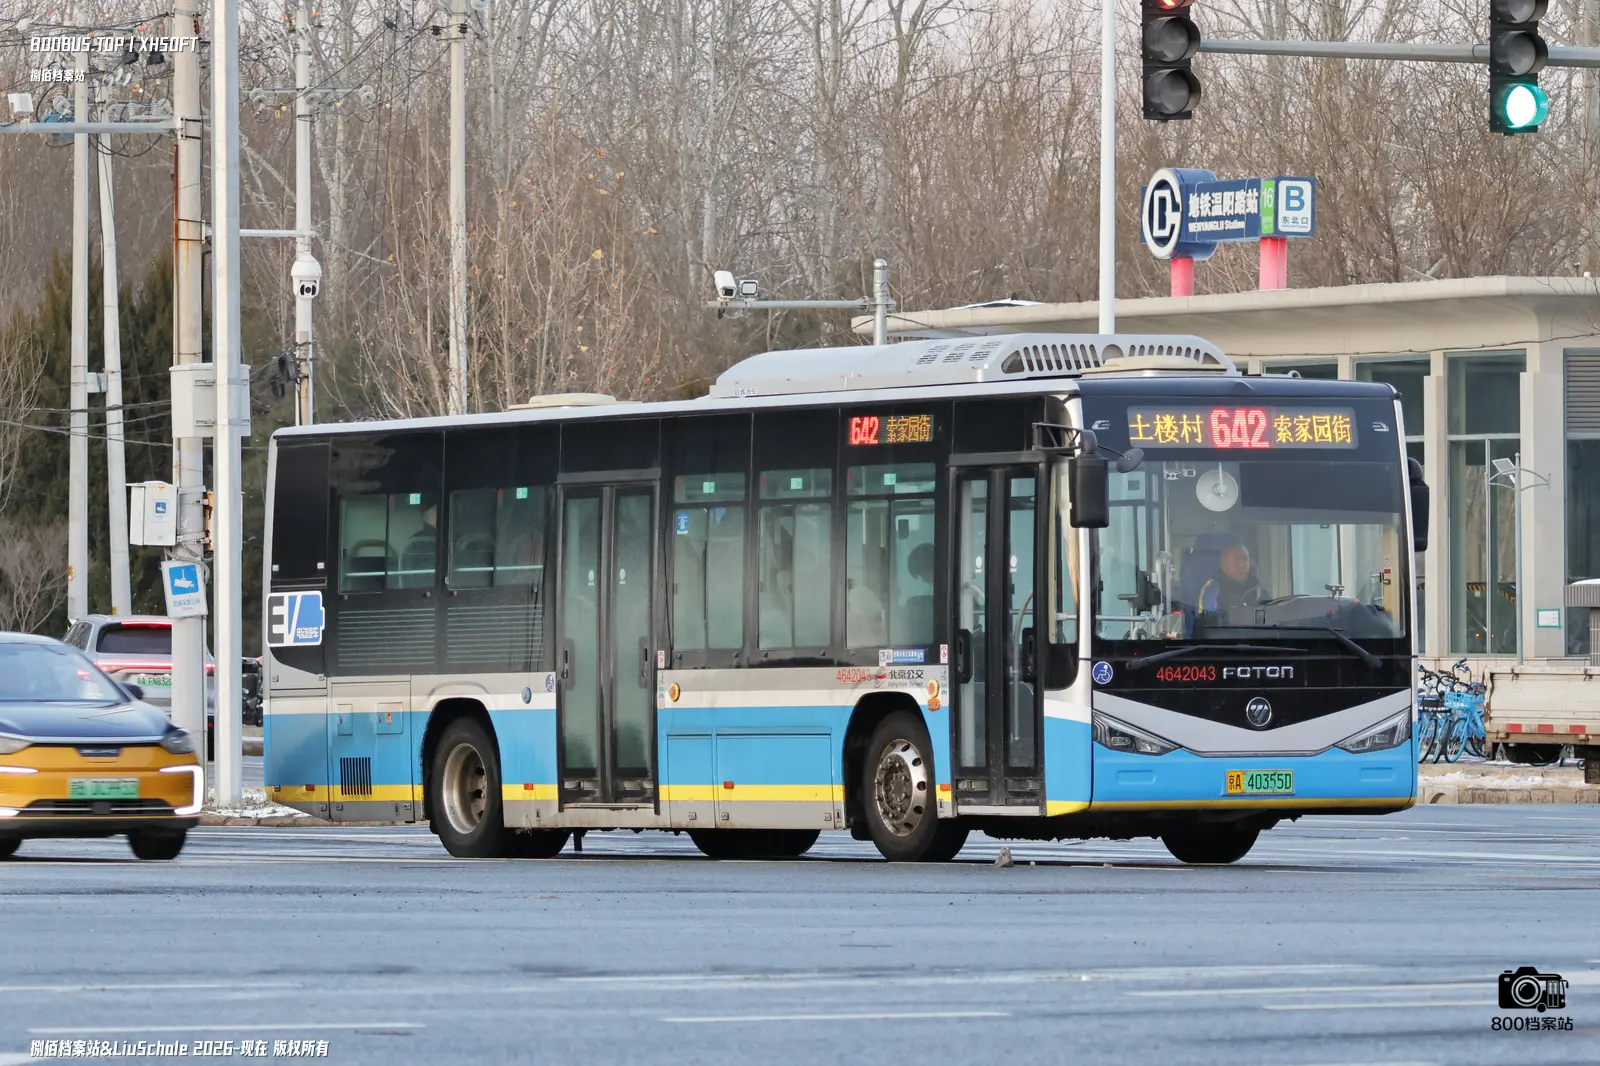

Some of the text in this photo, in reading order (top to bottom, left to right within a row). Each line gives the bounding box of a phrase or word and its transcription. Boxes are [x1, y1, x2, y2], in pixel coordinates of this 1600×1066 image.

[1188, 188, 1258, 217] 地铁温阳路站
[1262, 188, 1274, 208] 16
[1285, 185, 1305, 211] B
[1282, 216, 1309, 225] 东北口
[851, 416, 880, 445] 642
[886, 415, 931, 443] 索家园街
[1129, 409, 1351, 448] 土楼村 642 索家园街
[836, 668, 873, 683] 4642043
[888, 669, 925, 680] 北京公交
[1156, 665, 1294, 681] 4642043 FOTON
